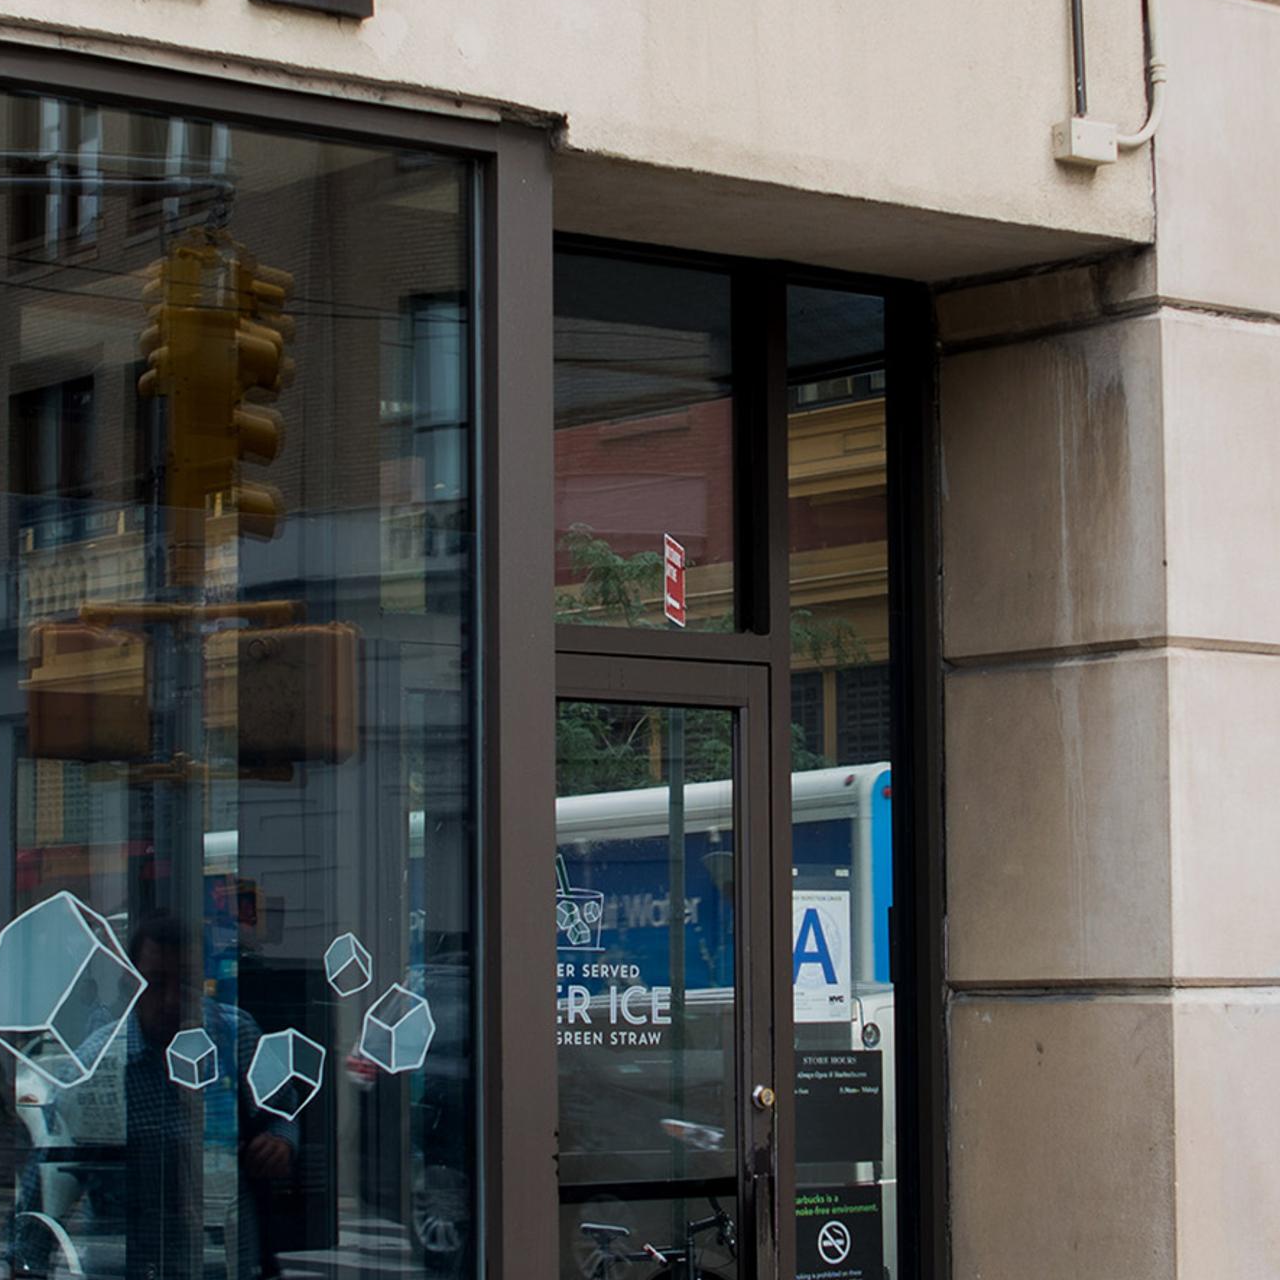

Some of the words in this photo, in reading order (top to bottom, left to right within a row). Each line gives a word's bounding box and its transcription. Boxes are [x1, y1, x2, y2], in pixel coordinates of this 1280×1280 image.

[793, 908, 838, 984] A
[582, 964, 640, 978] SERVED
[557, 985, 592, 1024] R
[610, 985, 672, 1024] ICE
[610, 1031, 662, 1045] STRAW
[803, 1056, 828, 1064] STORE
[830, 1056, 857, 1064] HOURS
